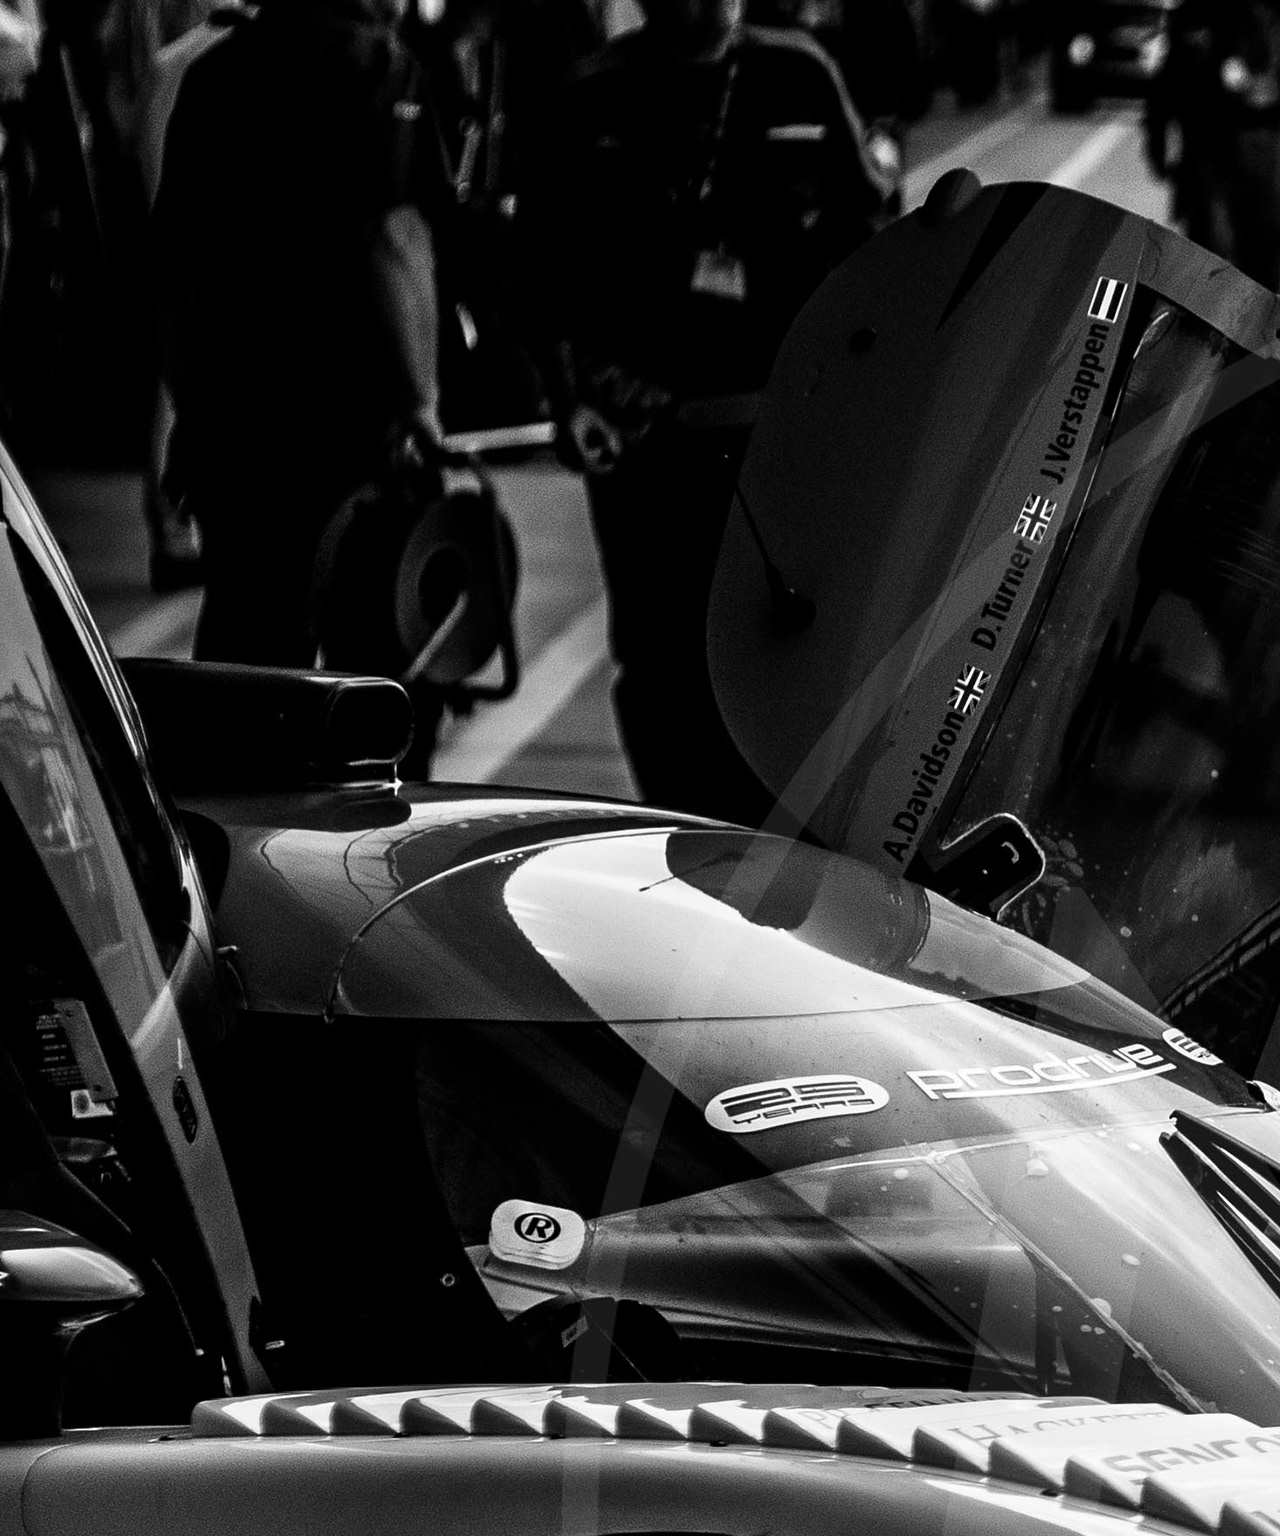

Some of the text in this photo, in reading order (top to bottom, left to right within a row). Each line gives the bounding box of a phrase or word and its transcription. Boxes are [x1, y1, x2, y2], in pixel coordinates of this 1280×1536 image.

[1040, 322, 1110, 486] J.Verstappen
[882, 709, 967, 864] A.Davidson
[719, 1081, 867, 1118] 25
[906, 1043, 1163, 1099] prodrive
